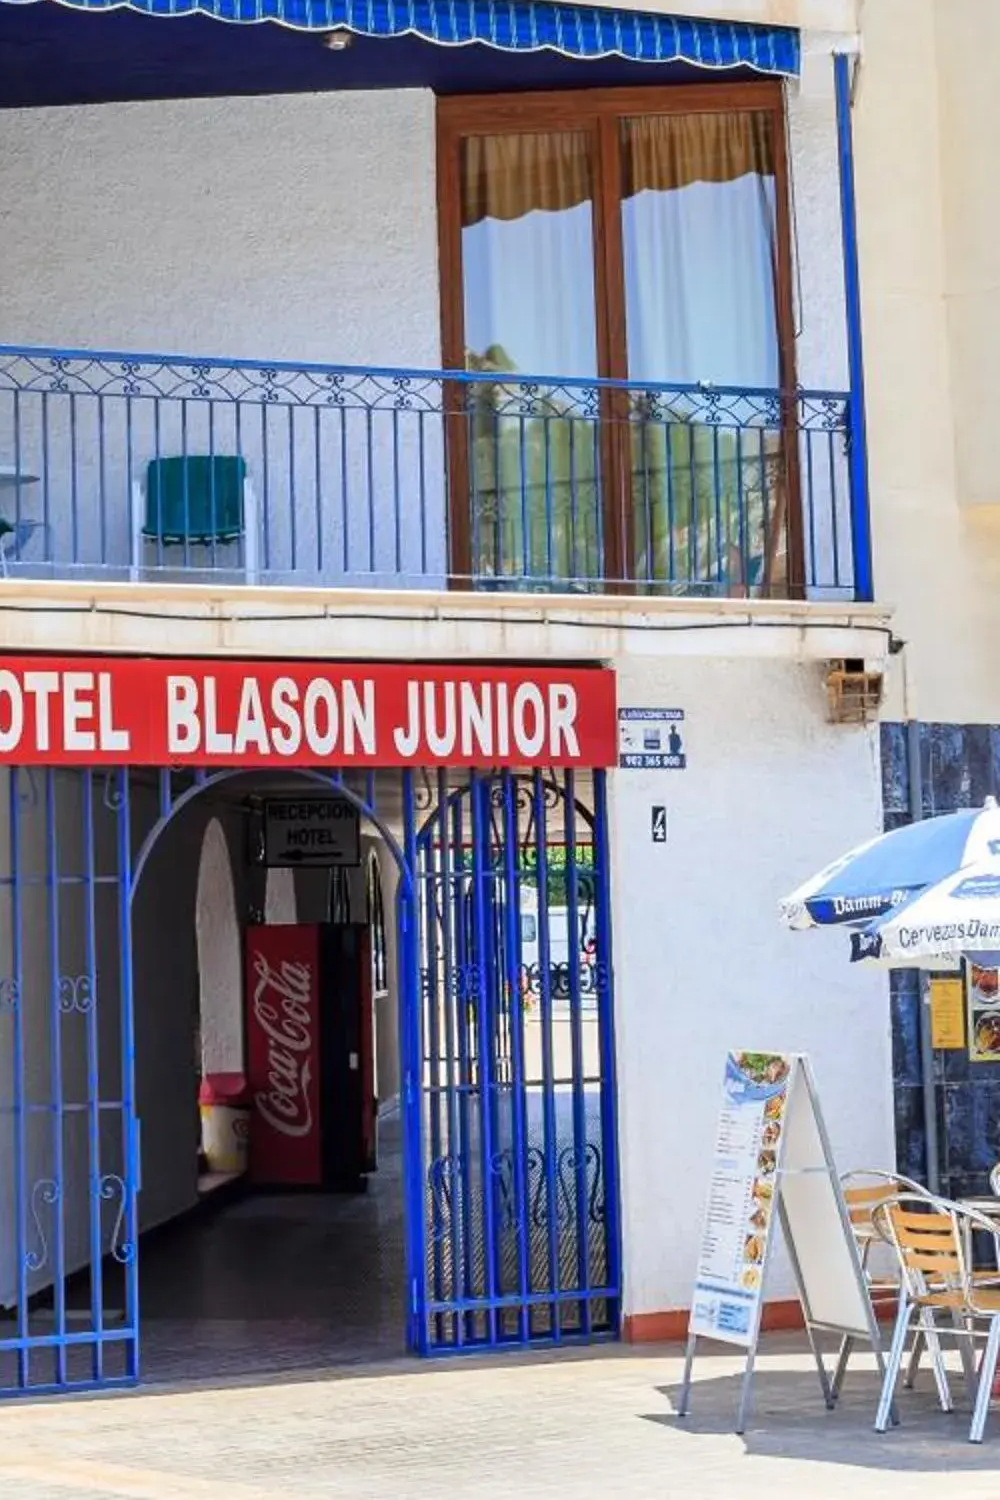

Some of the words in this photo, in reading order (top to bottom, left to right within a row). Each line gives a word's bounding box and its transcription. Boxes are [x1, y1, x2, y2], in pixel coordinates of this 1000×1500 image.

[166, 675, 377, 756] BLASON
[393, 680, 581, 757] JUNIOR
[287, 828, 337, 845] HOTEL
[653, 809, 665, 840] 4
